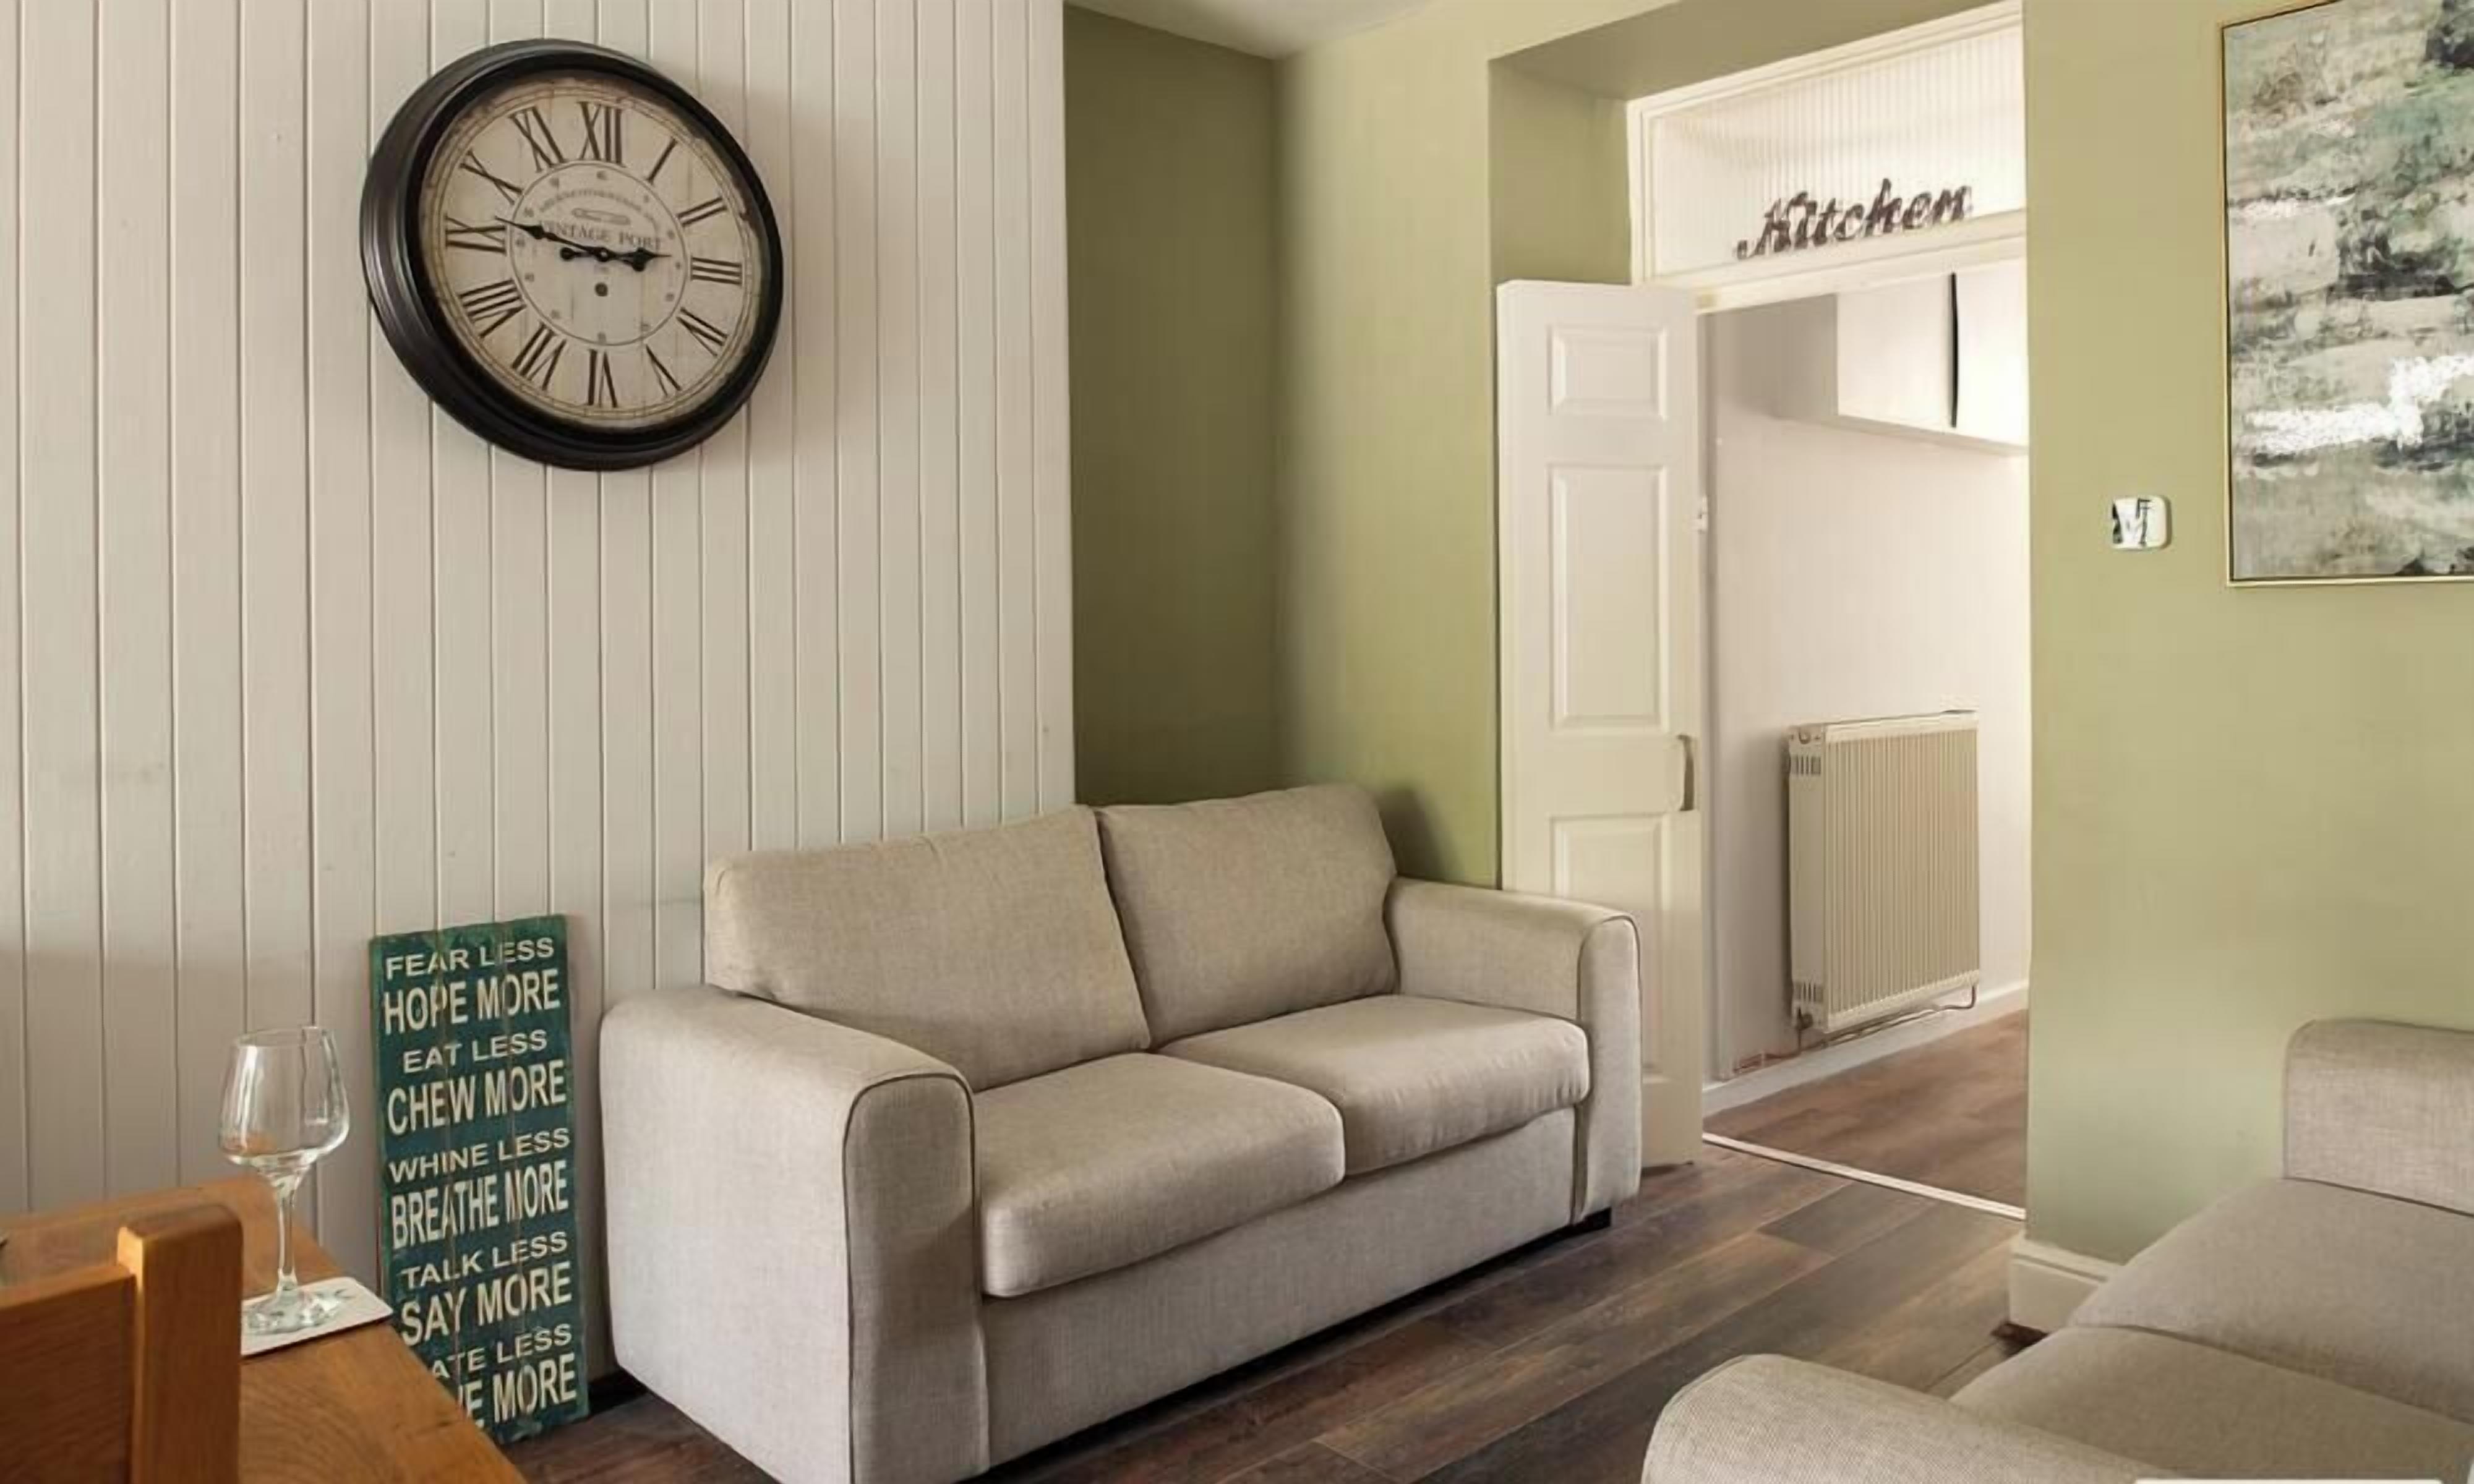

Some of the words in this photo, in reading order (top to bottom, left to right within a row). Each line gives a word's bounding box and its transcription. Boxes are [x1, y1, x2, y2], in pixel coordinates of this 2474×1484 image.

[508, 107, 567, 172] XI
[580, 101, 623, 163] XII
[1736, 177, 1973, 260] Kitchen
[385, 948, 471, 980] FEAR
[479, 937, 555, 967] LESS
[383, 981, 469, 1034] HOPE
[477, 968, 561, 1020] MORE
[403, 1043, 463, 1073] EAT
[472, 1030, 548, 1062] LESS
[387, 1075, 476, 1135] CHEW
[485, 1059, 567, 1117] MORE
[388, 1143, 490, 1183] WHINE
[498, 1128, 570, 1161] LESS
[392, 1175, 499, 1250] BREATHE
[505, 1161, 569, 1222] MORE
[401, 1250, 484, 1290] TALK
[492, 1231, 568, 1268] LESS
[401, 1287, 468, 1346] SAY
[477, 1261, 573, 1326] MORE
[432, 1347, 487, 1379] ATE
[497, 1324, 572, 1363] LESS
[494, 1352, 578, 1423] MORE
